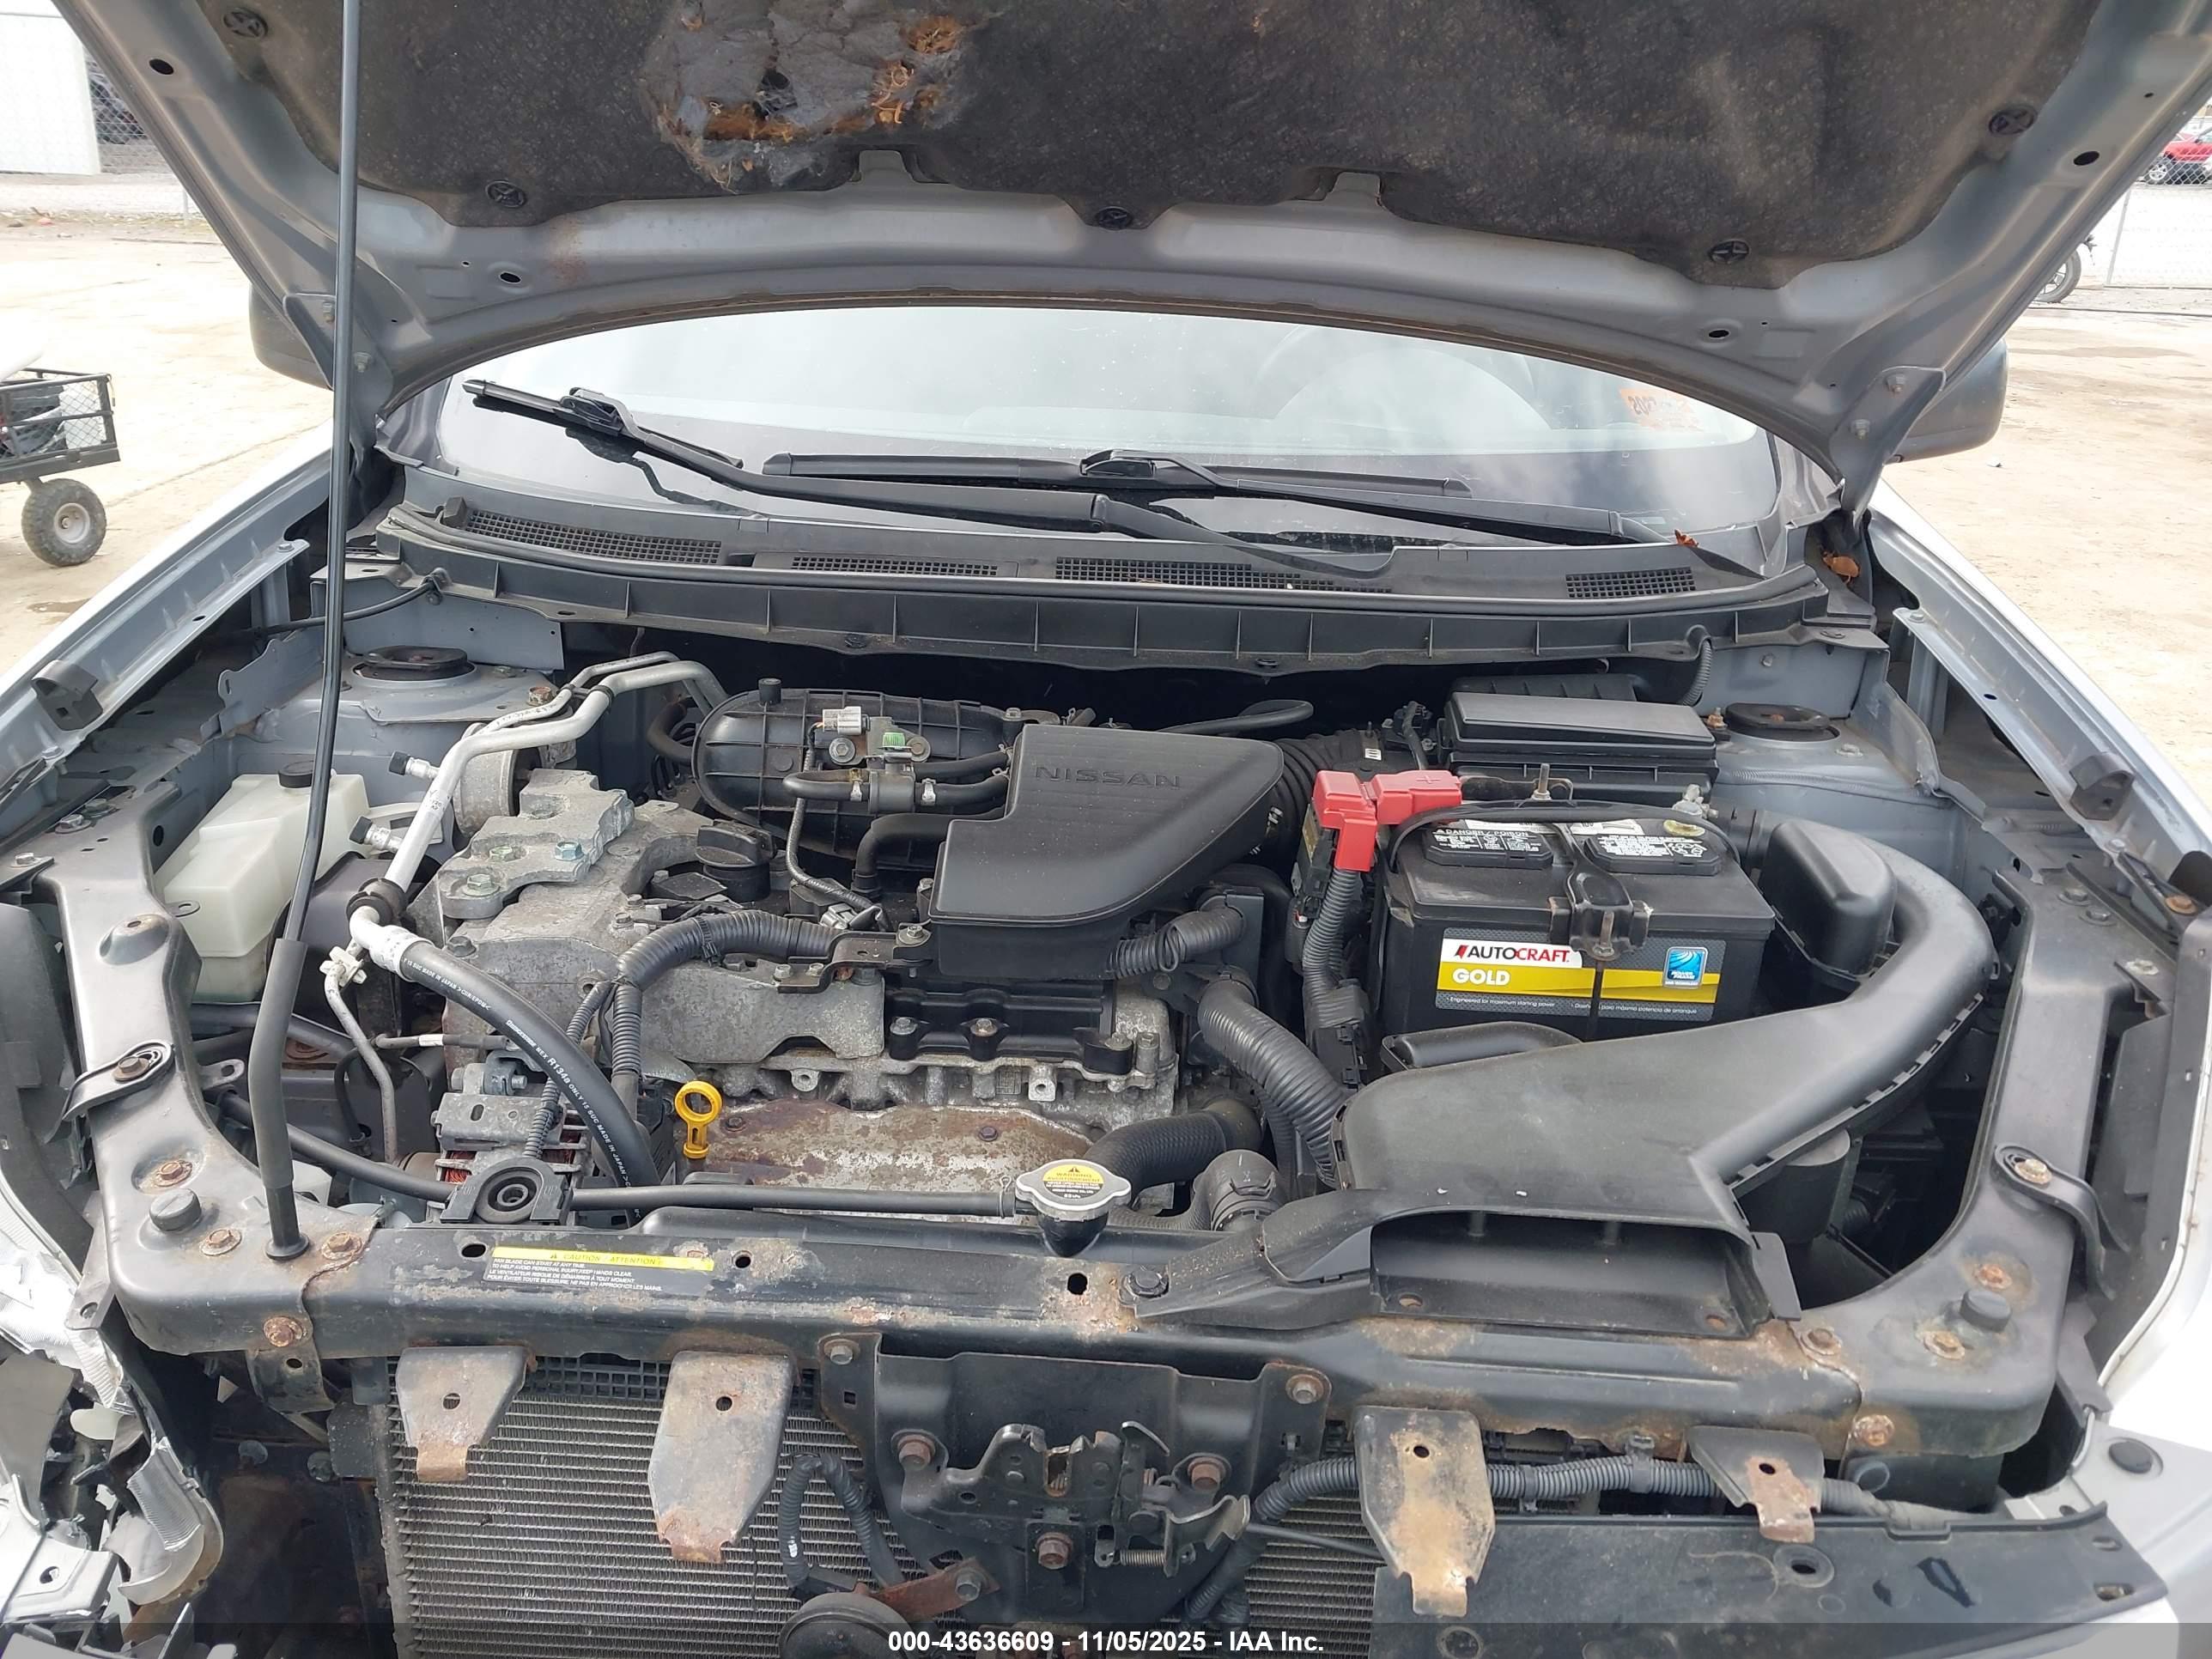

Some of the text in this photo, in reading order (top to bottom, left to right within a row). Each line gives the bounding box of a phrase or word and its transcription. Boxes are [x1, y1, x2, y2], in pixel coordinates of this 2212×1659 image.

[1035, 767, 1181, 787] NISSAN
[1467, 945, 1570, 963] AUTOCRAFT
[1452, 968, 1511, 986] GOLD
[568, 1084, 584, 1100] ONLY
[597, 1124, 611, 1144] MADE
[612, 1153, 628, 1175] JAPAN
[563, 1254, 600, 1262] CAUTION
[609, 1256, 657, 1265] ATTENTION
